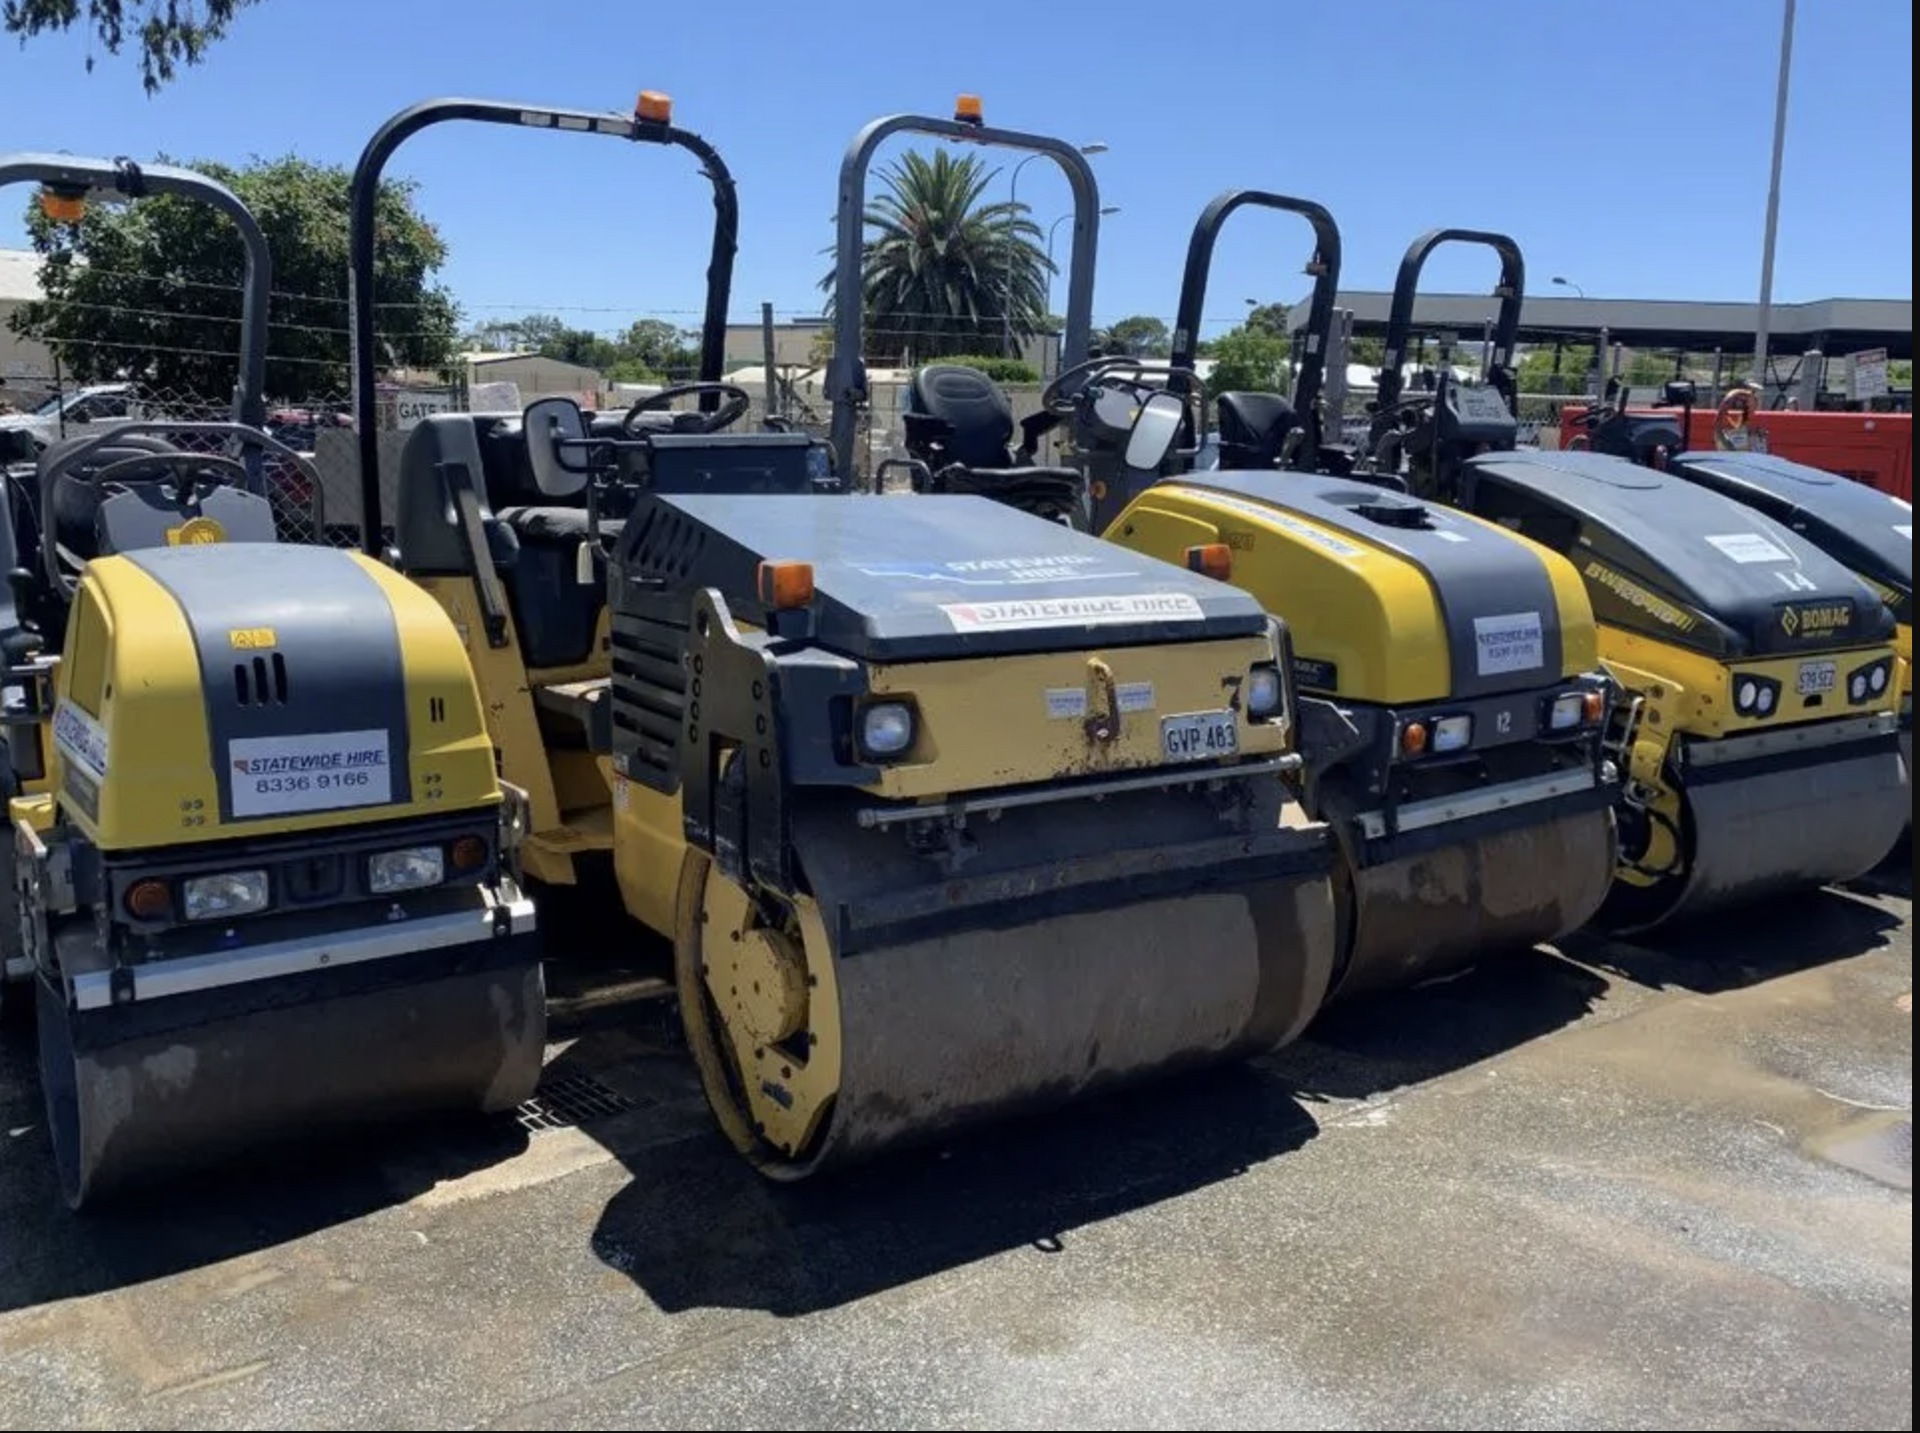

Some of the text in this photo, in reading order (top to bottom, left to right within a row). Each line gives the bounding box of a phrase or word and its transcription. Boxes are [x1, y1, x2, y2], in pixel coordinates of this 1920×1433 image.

[1801, 606, 1849, 629] BOMAG
[1168, 724, 1236, 752] GVP 483
[250, 750, 384, 772] STATEWIDE HIRE
[256, 771, 369, 793] 8336 9166
